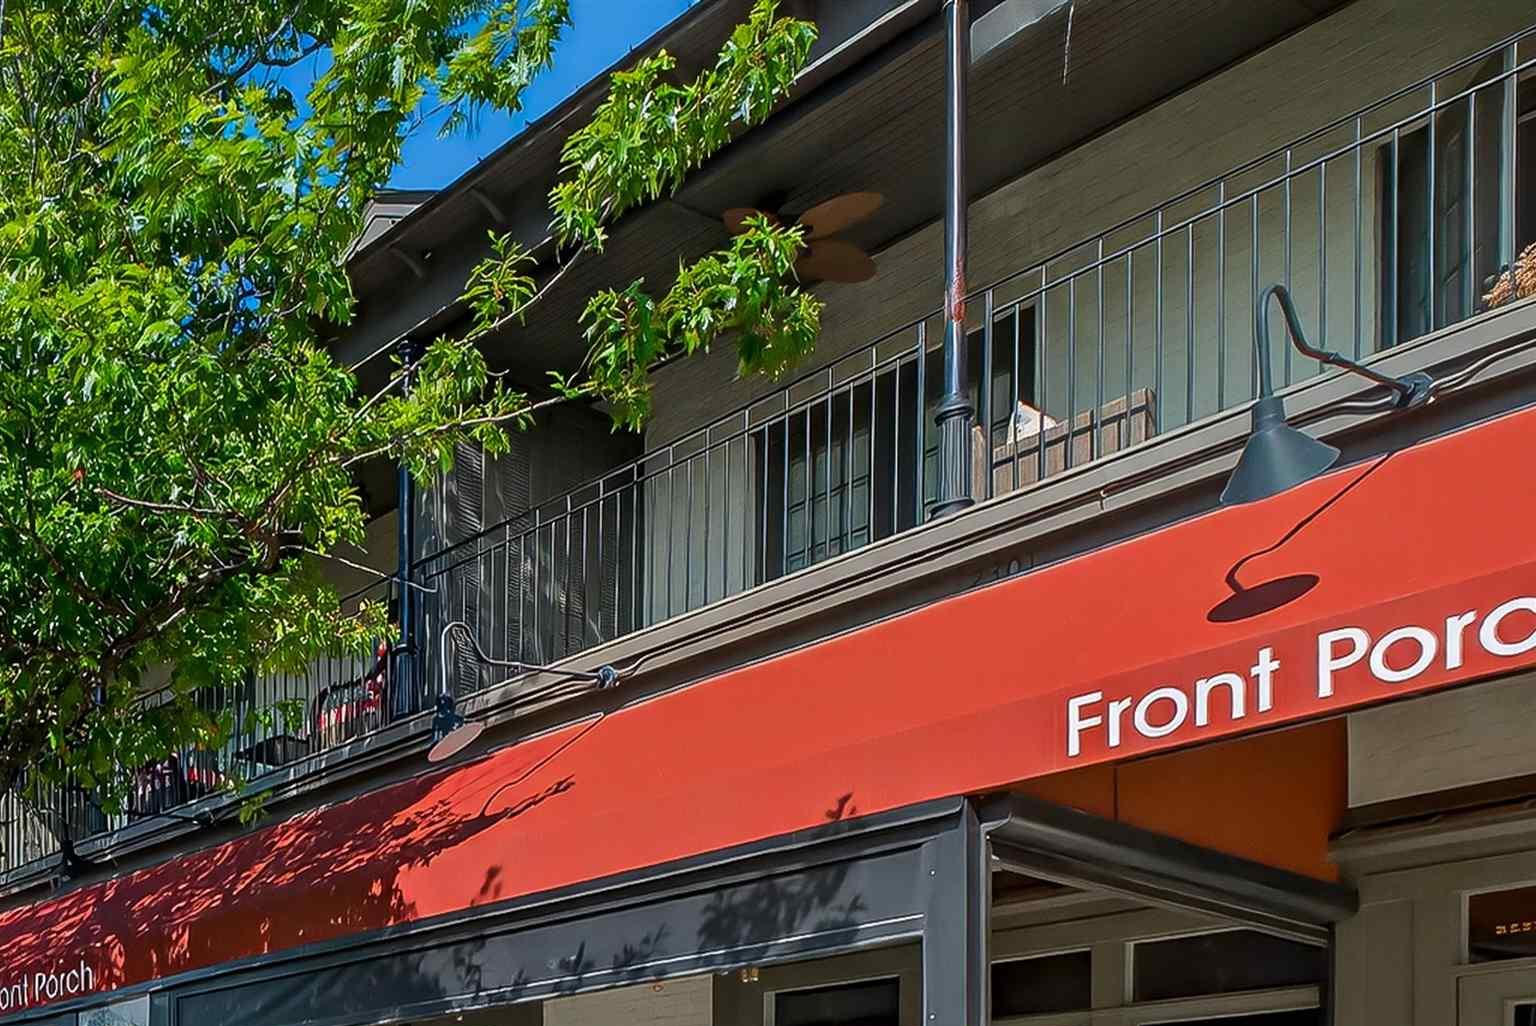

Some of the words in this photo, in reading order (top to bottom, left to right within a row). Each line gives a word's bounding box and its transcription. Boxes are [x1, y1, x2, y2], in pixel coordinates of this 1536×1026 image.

[1066, 645, 1281, 758] Front
[1316, 595, 1536, 698] Porc
[35, 960, 93, 1001] Porch
